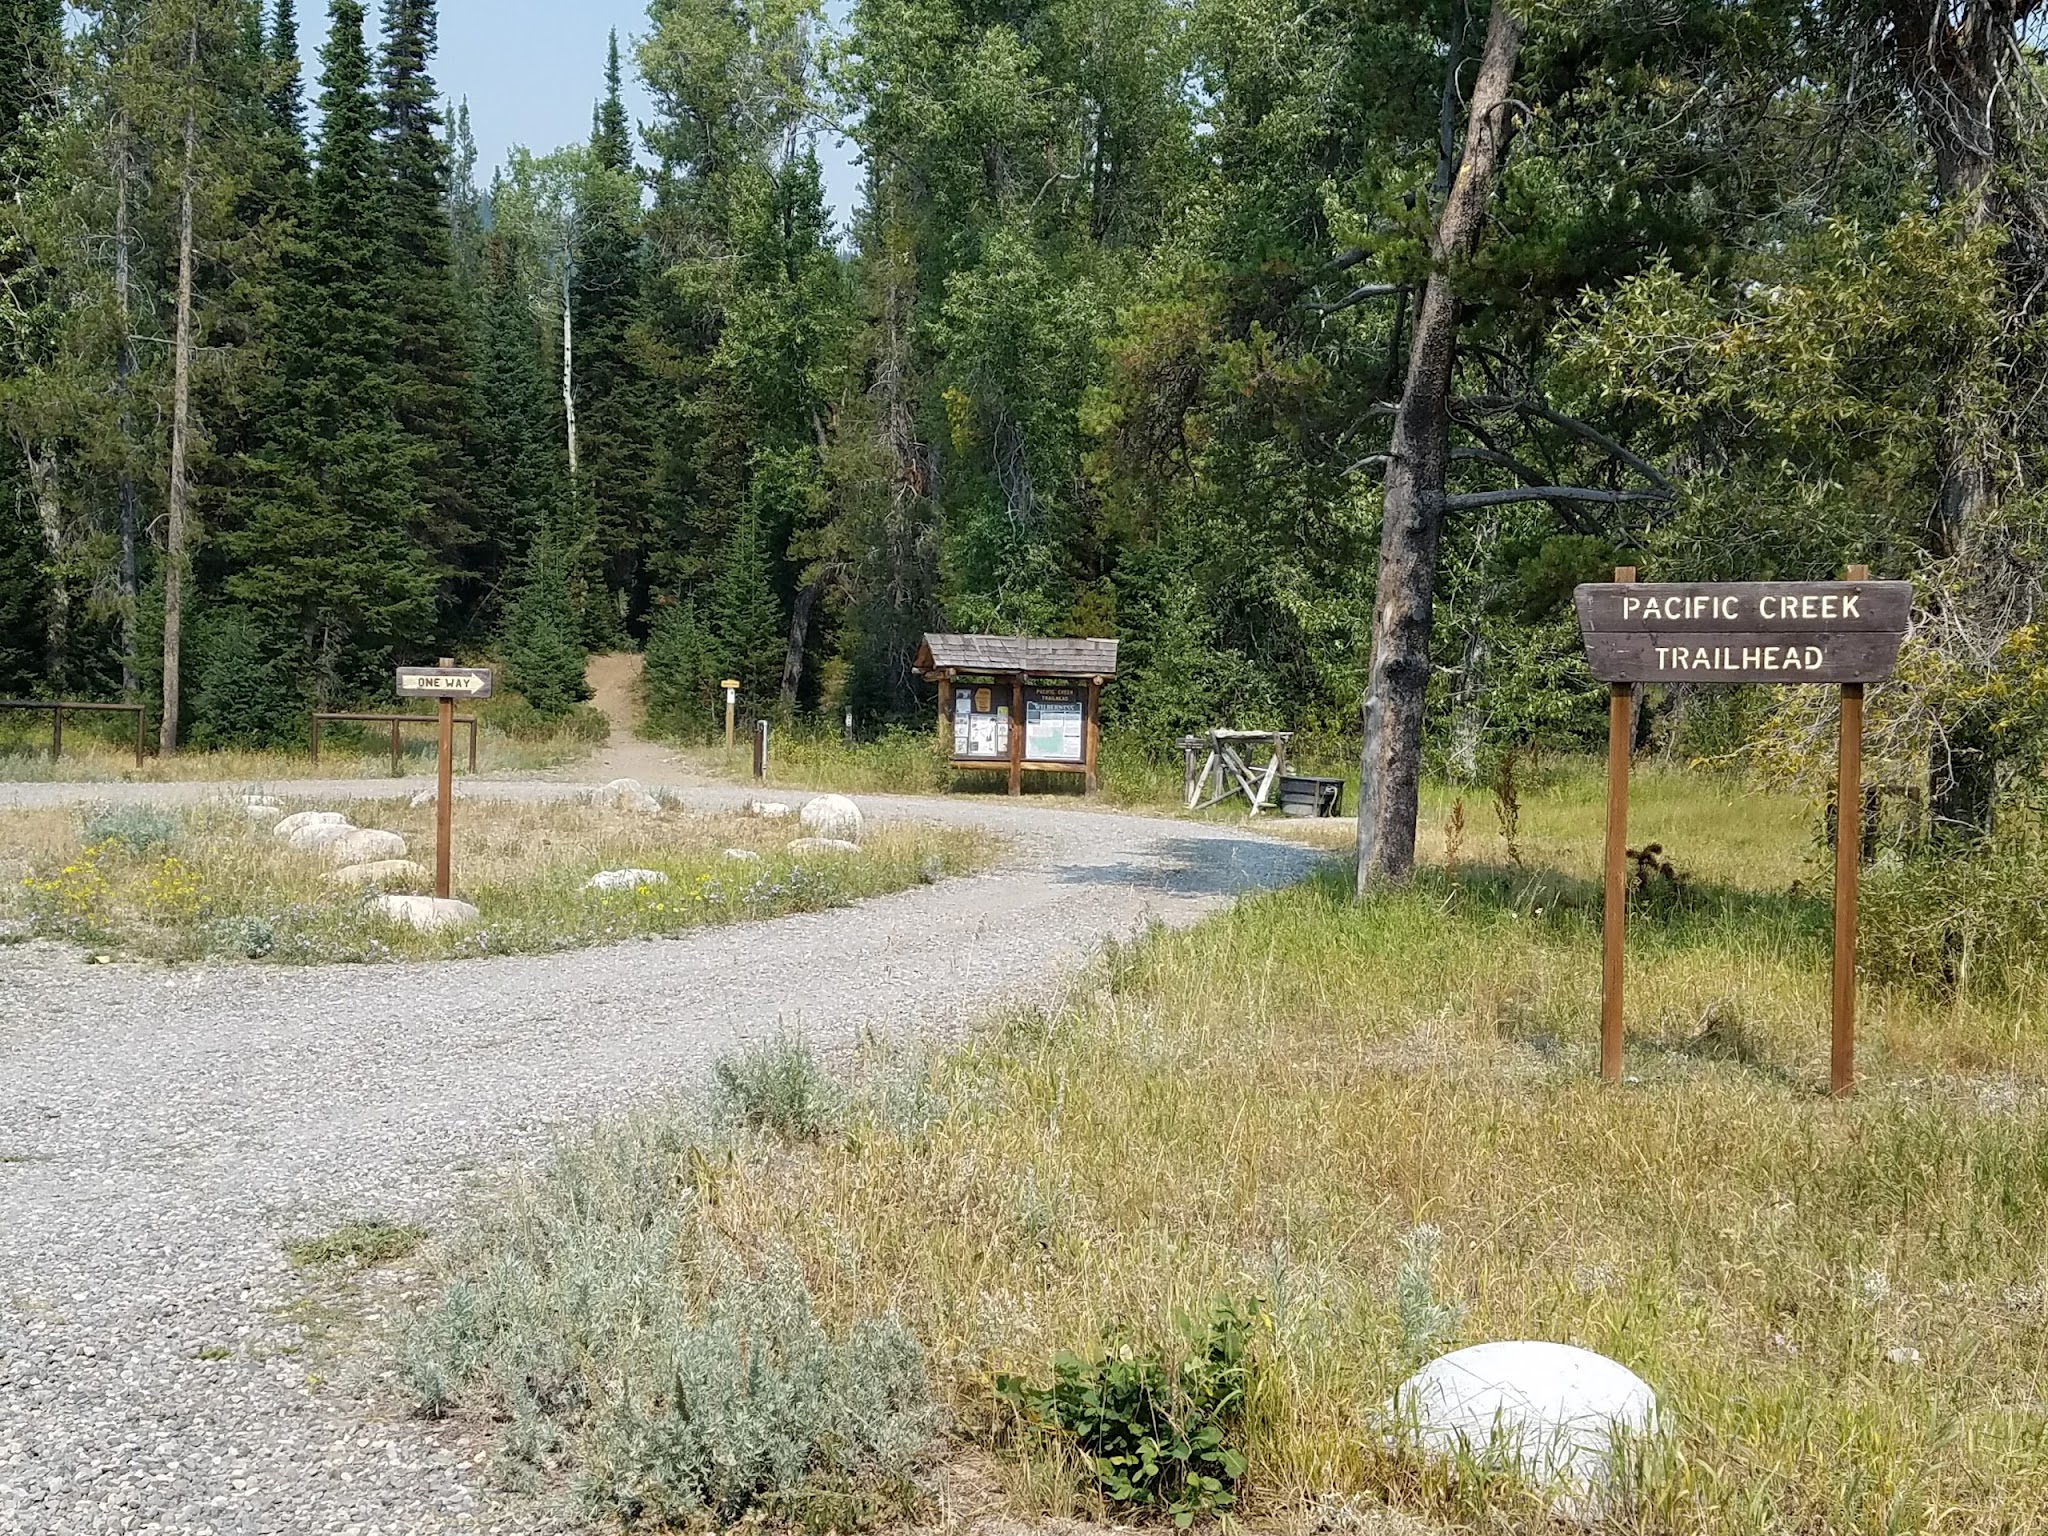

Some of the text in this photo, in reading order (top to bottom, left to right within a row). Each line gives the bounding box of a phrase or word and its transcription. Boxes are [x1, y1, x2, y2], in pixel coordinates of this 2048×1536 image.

[1623, 595, 1860, 620] PACIFIC CREEK
[1655, 647, 1823, 670] TRAILHEAD
[418, 678, 470, 688] ONE WAY
